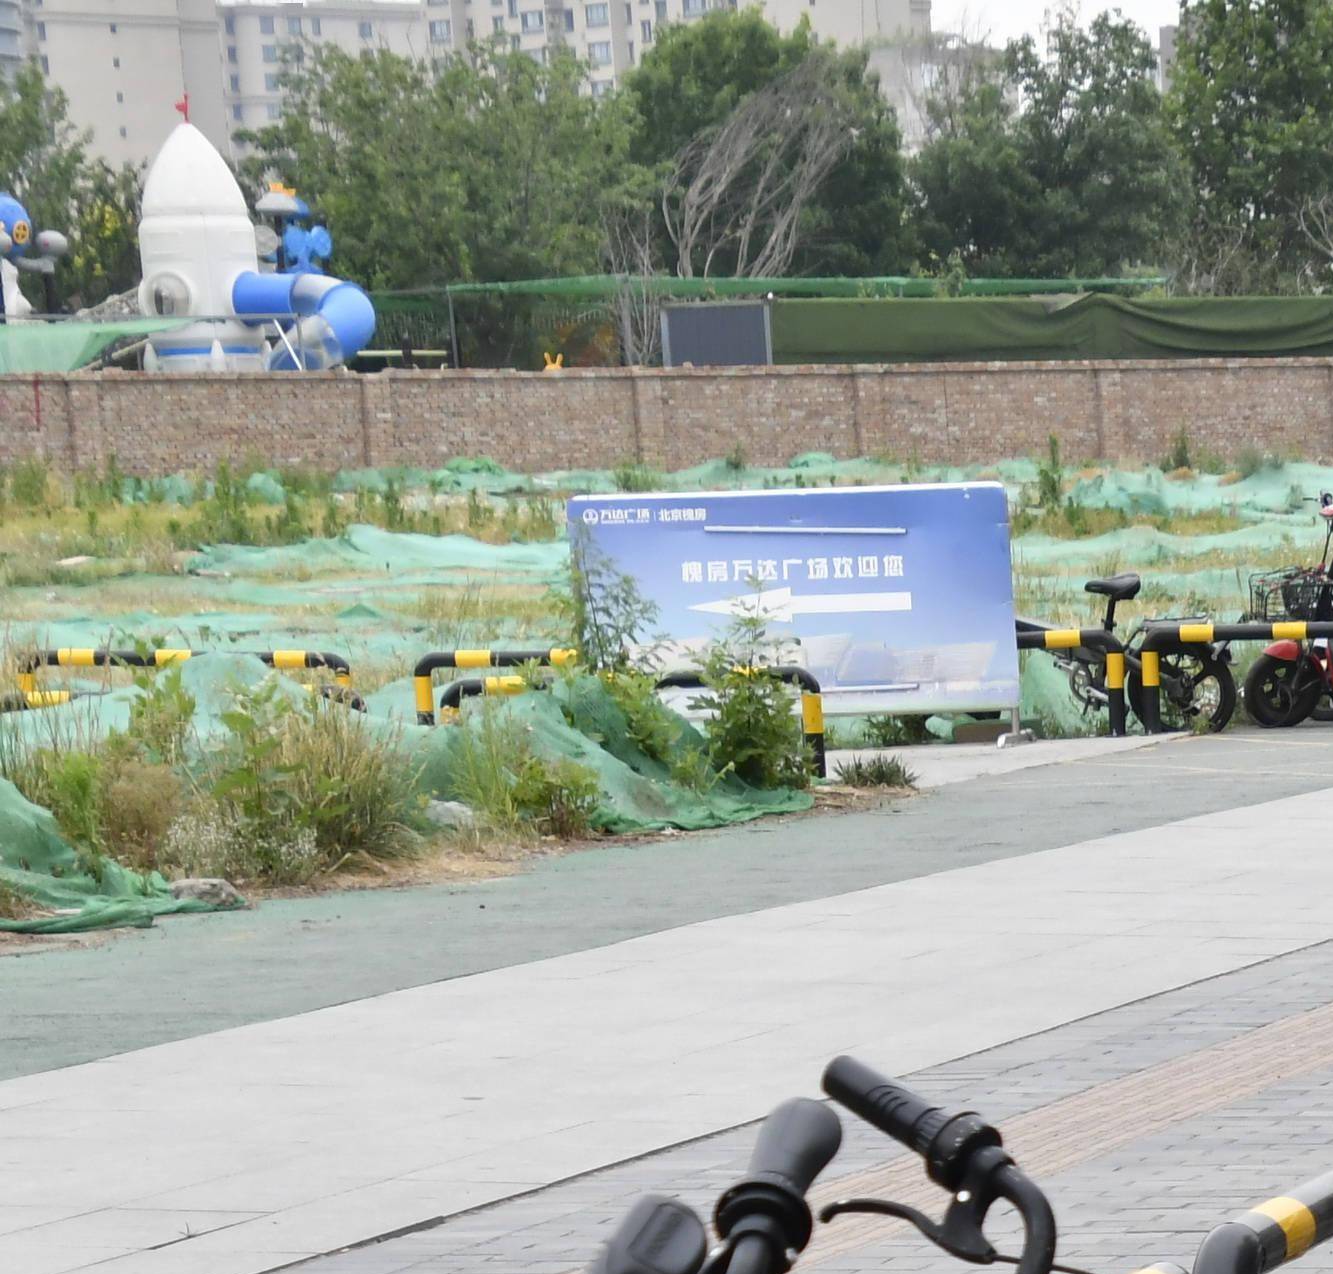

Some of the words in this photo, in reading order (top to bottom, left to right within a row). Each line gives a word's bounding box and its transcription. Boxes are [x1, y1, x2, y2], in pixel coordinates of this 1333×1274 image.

[681, 554, 904, 583] 槐房万达广场欢迎您
